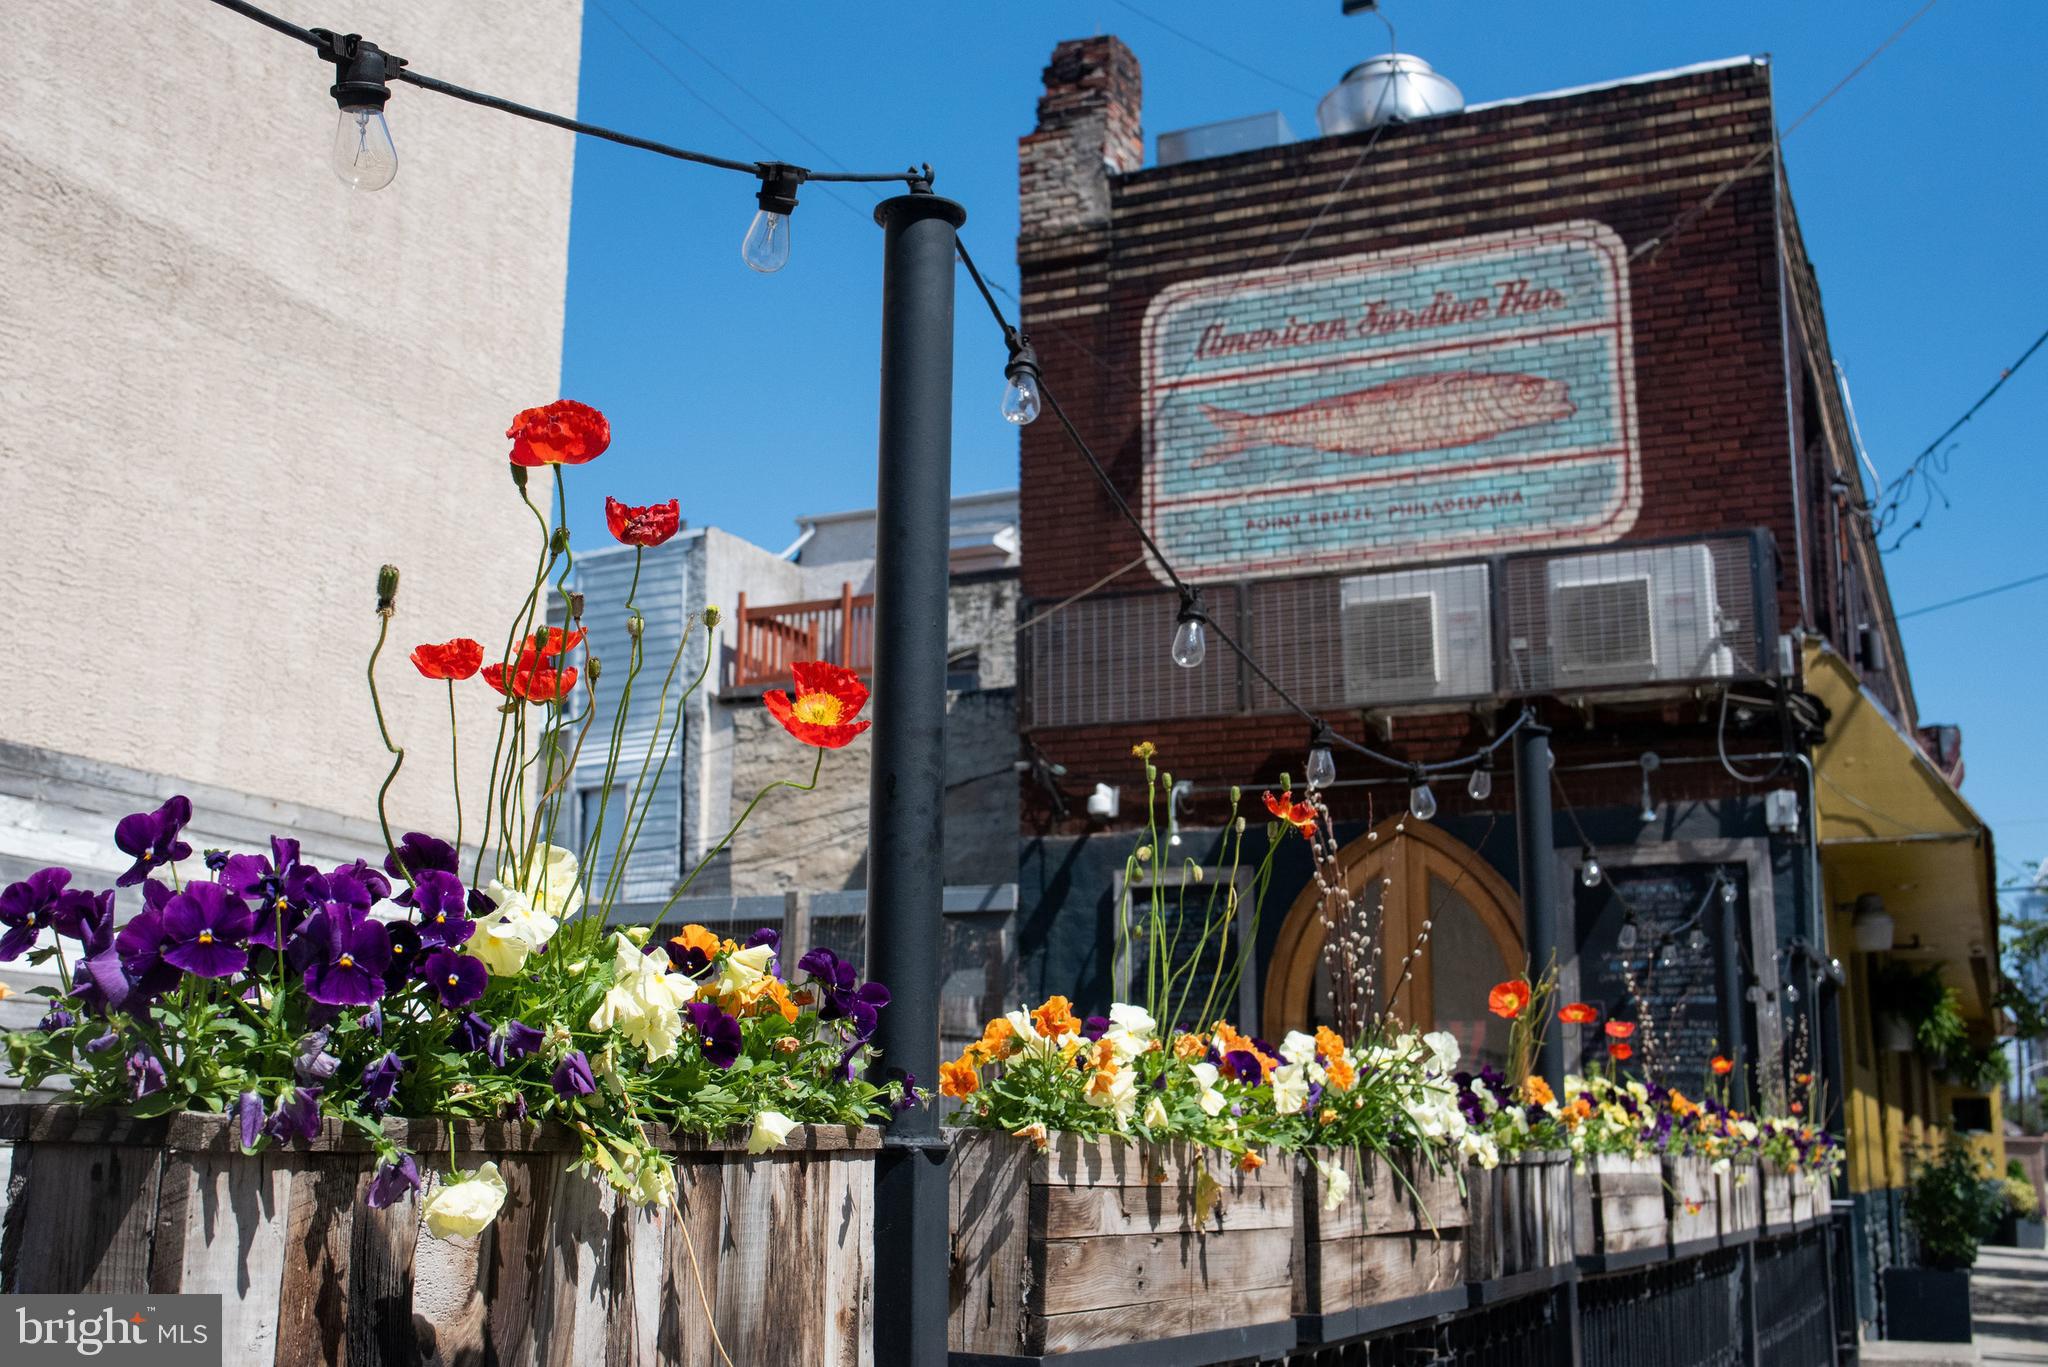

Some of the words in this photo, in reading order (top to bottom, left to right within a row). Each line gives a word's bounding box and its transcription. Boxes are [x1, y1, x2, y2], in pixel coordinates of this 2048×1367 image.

[1195, 315, 1347, 360] American
[1356, 291, 1489, 336] Sardine
[1494, 278, 1564, 315] Bar
